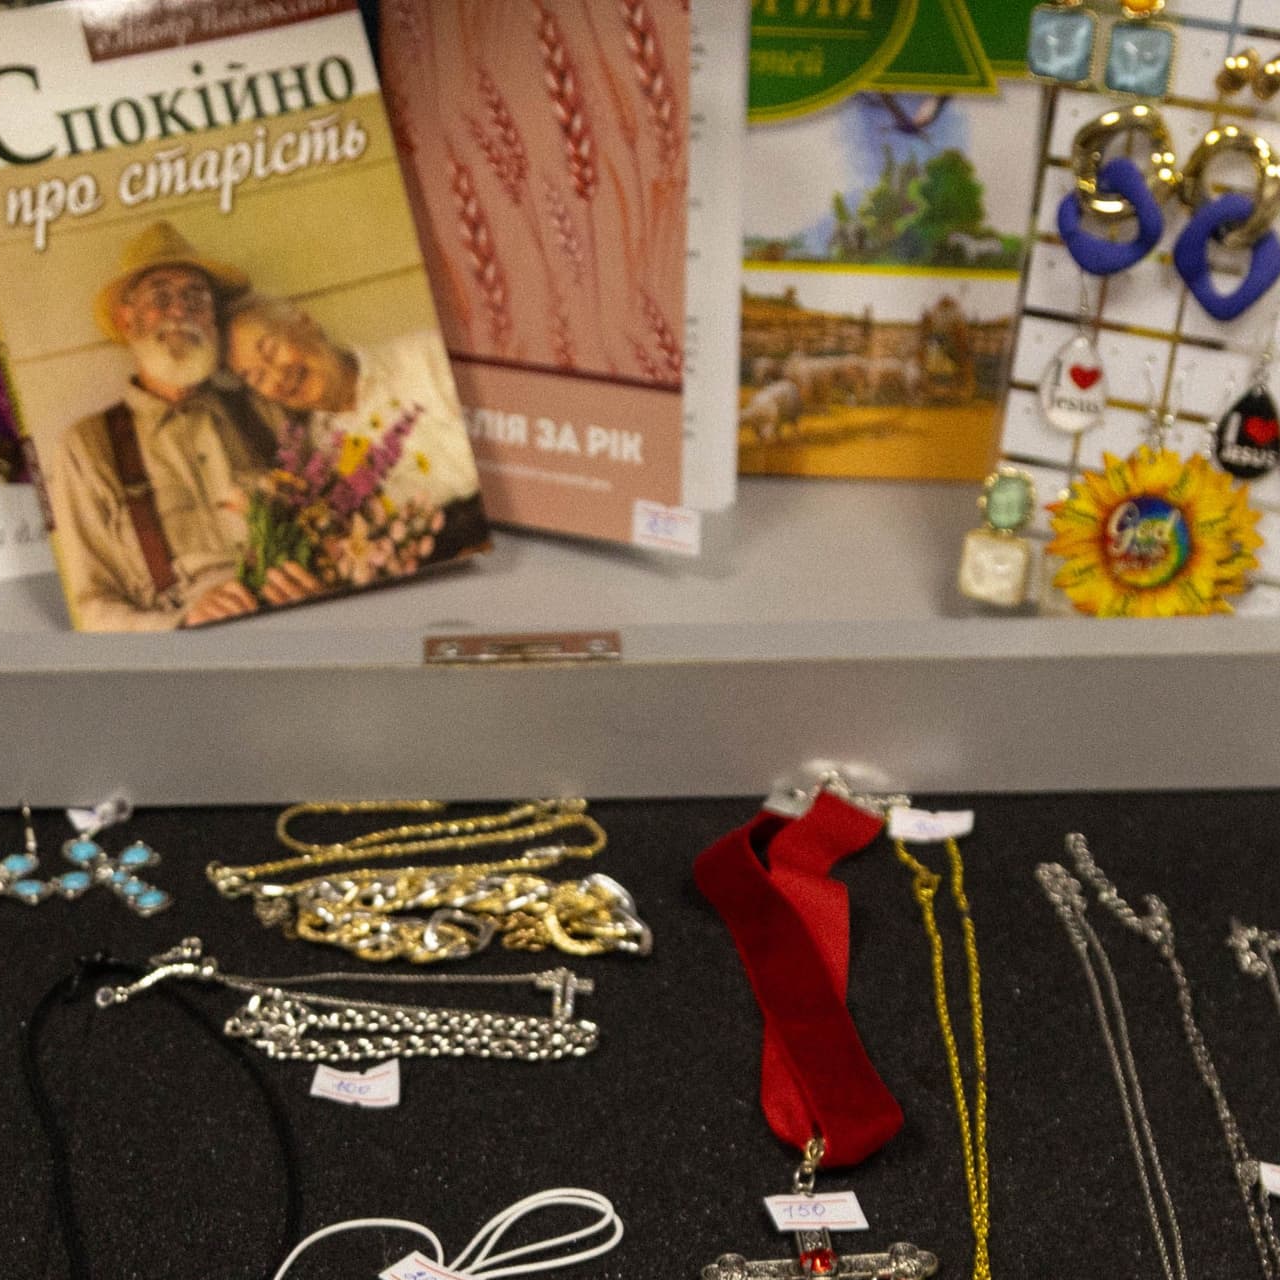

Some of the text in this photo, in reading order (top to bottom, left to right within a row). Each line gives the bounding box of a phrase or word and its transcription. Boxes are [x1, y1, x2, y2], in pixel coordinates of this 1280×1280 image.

[5, 114, 368, 253] про старість
[534, 416, 582, 453] ЗА
[586, 424, 645, 466] РІК
[783, 1202, 825, 1219] 150
